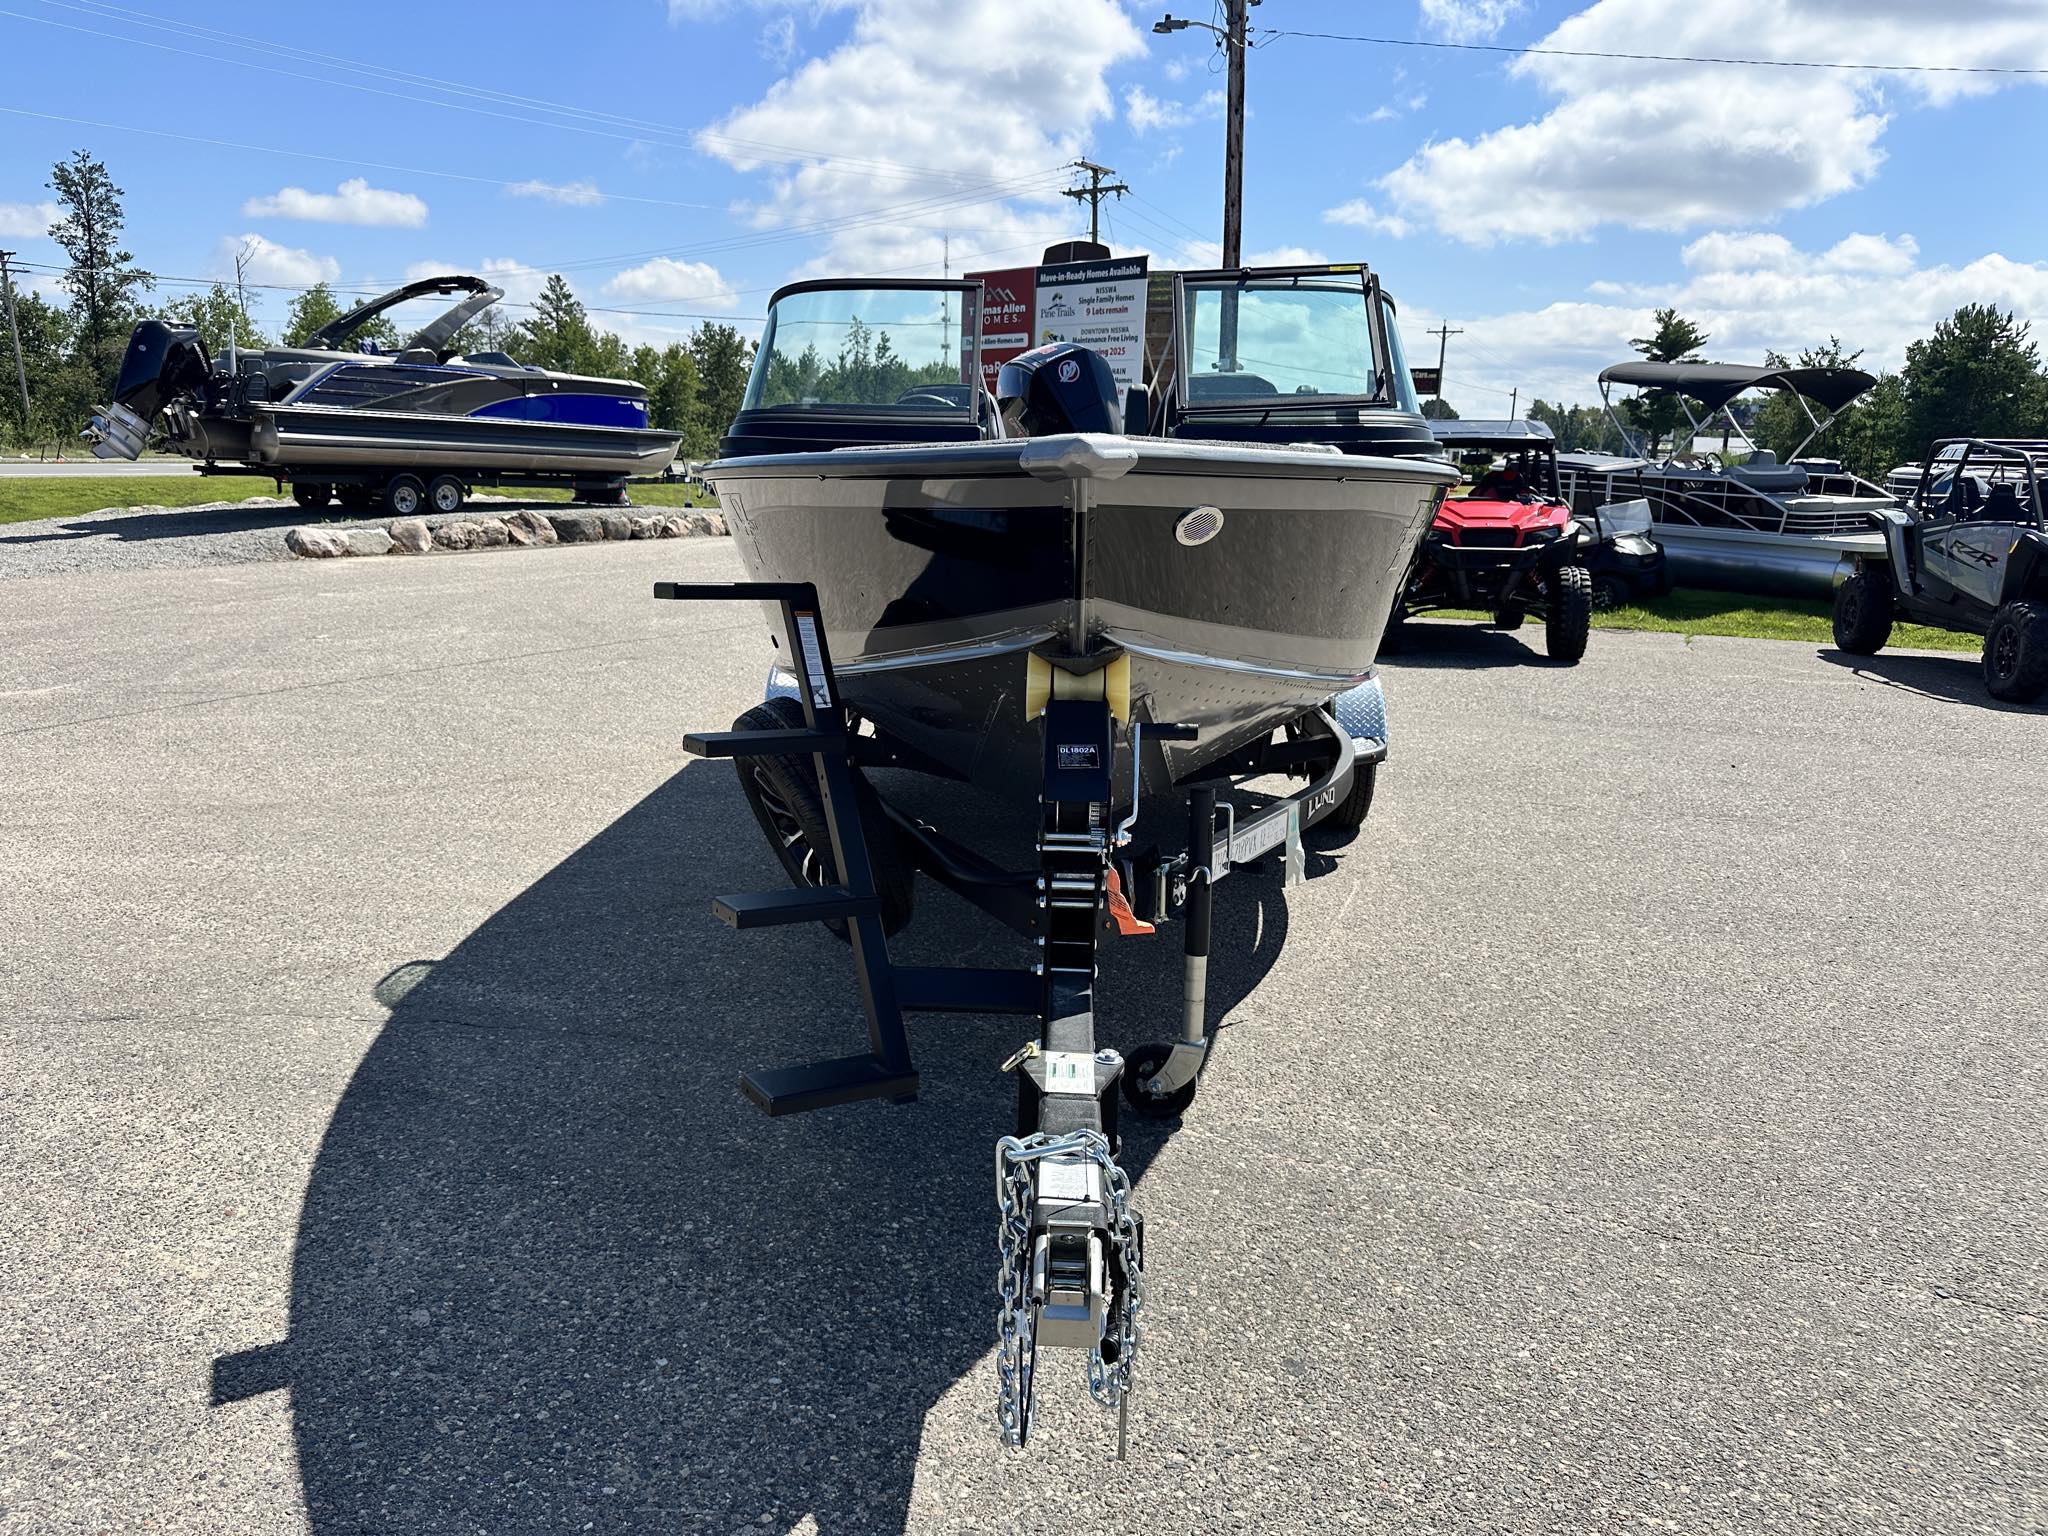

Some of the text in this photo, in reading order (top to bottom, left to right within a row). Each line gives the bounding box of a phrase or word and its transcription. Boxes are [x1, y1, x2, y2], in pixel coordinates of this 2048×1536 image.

[1040, 265, 1141, 283] Move-in-Ready Homes Available
[1096, 286, 1117, 294] NISSWA
[1078, 297, 1095, 305] Single
[1096, 295, 1114, 304] Family
[1002, 304, 1026, 313] Allen
[1040, 306, 1076, 319] Pine Trails
[1086, 305, 1128, 316] 9 Lots remain
[1081, 326, 1129, 335] DOWNTOWN NISSWA
[1072, 335, 1107, 344] Maintenance
[1120, 334, 1139, 343] Living
[1109, 346, 1126, 356] 2025
[1950, 539, 1999, 569] RZR
[1307, 787, 1336, 821] LUND
